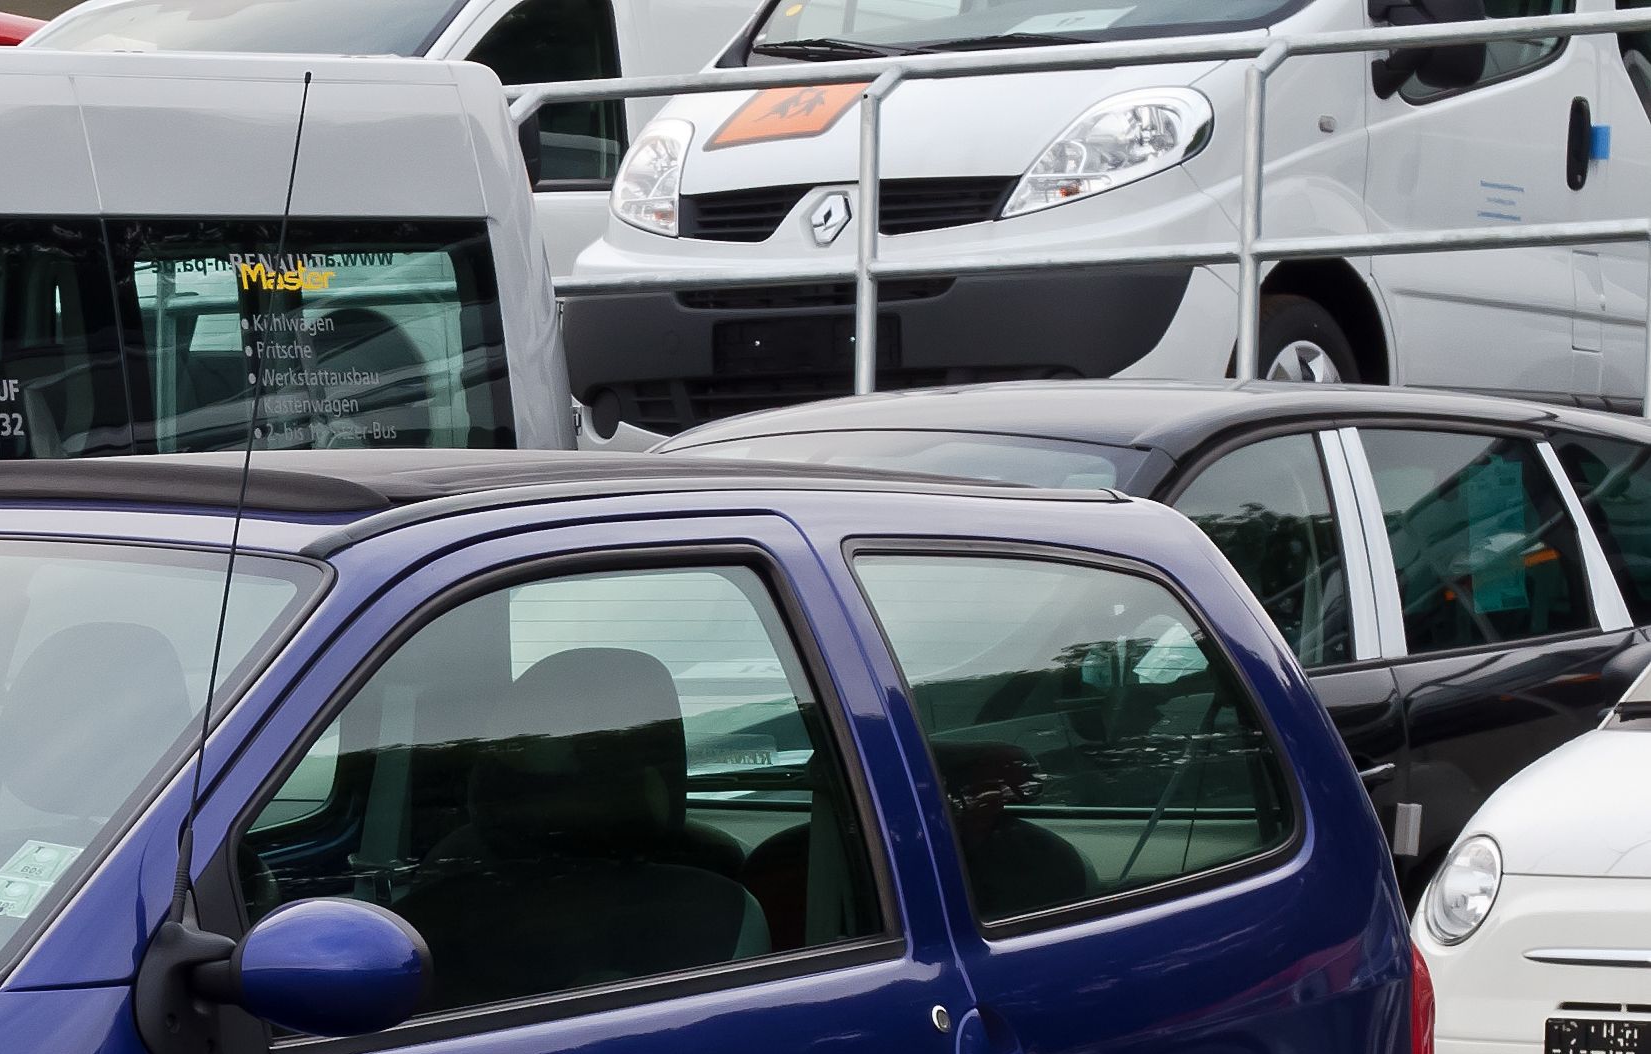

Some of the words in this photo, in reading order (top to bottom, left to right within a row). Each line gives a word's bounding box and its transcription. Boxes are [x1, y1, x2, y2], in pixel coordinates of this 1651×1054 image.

[240, 260, 336, 290] Master
[257, 341, 313, 359] Pritsche
[263, 368, 380, 386] Werkstattausbau
